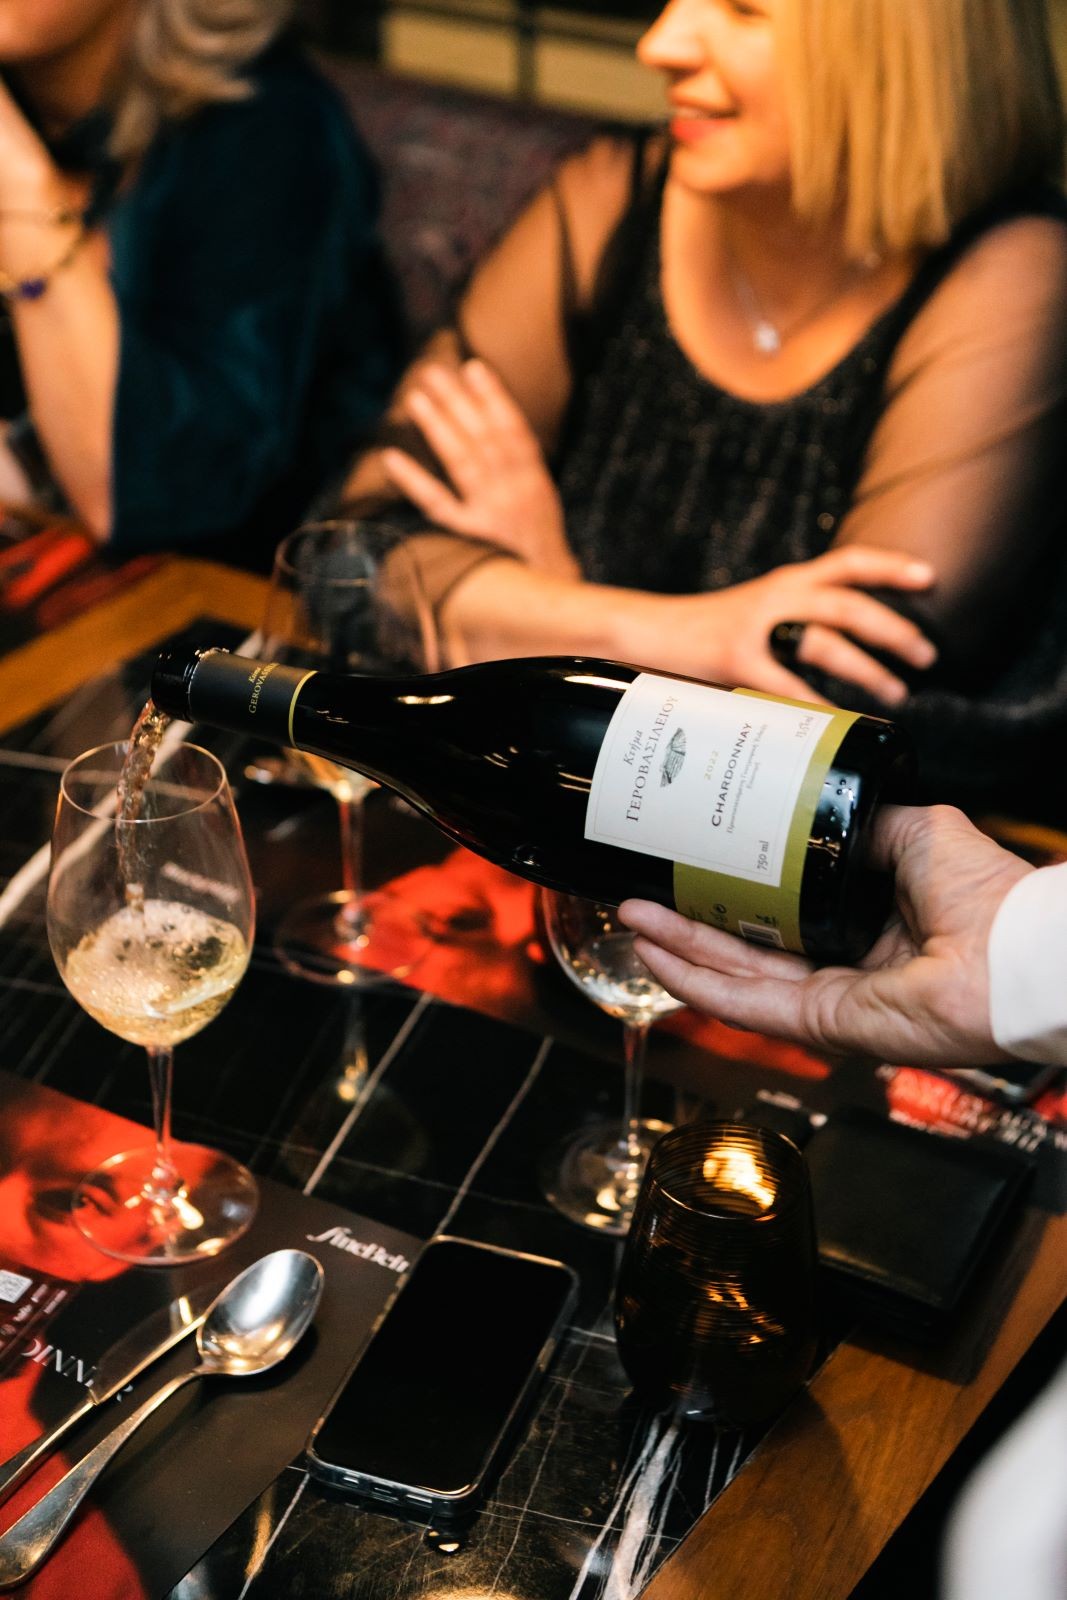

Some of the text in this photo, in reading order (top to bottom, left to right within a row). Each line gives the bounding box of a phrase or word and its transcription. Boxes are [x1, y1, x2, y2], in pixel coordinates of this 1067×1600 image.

[703, 750, 719, 781] 2022
[711, 722, 753, 828] CHARDONNAY
[756, 840, 770, 871] 750 ml
